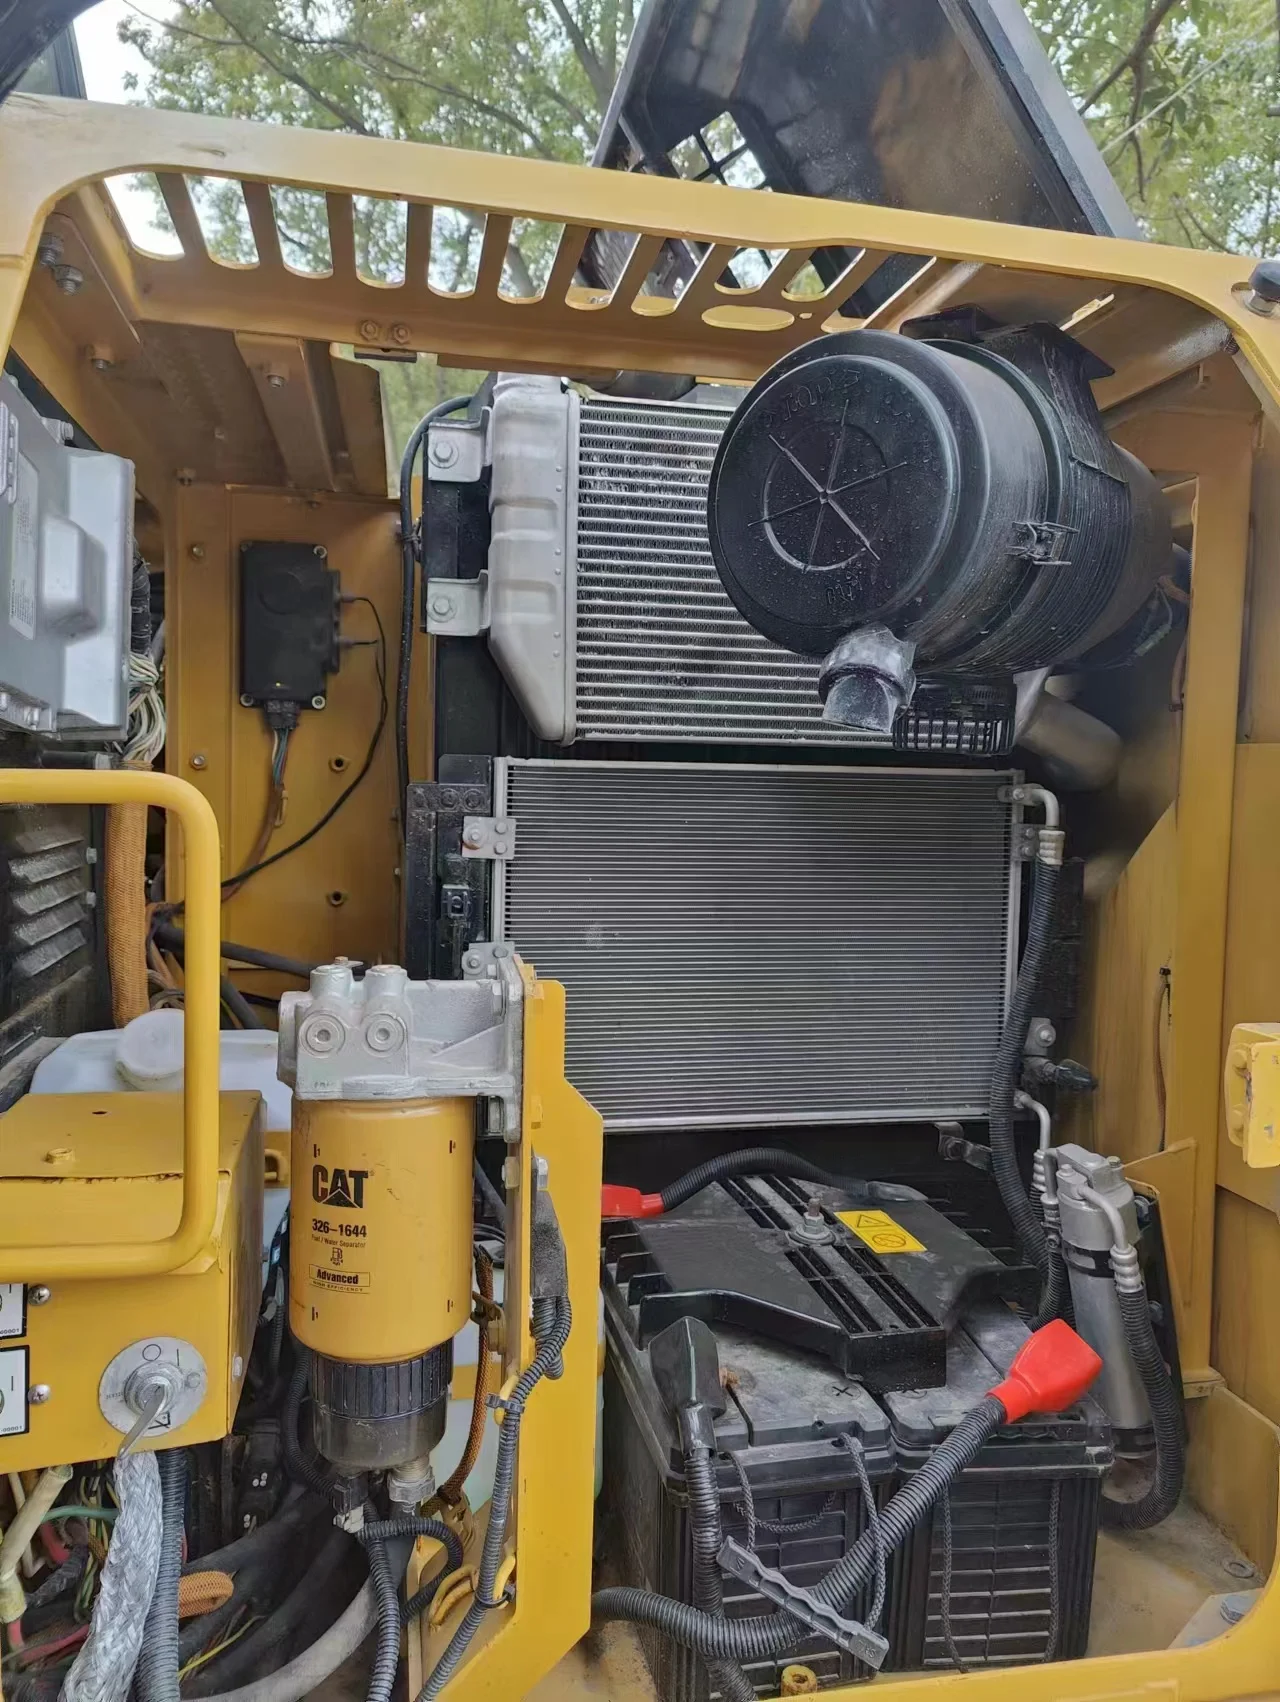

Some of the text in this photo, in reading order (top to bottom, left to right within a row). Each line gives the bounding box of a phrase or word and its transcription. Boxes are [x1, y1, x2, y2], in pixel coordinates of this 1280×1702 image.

[312, 1164, 369, 1208] CAT
[312, 1218, 367, 1238] 326-1644
[324, 1238, 338, 1246] Water
[339, 1240, 366, 1248] Separator
[316, 1269, 359, 1284] Advanced
